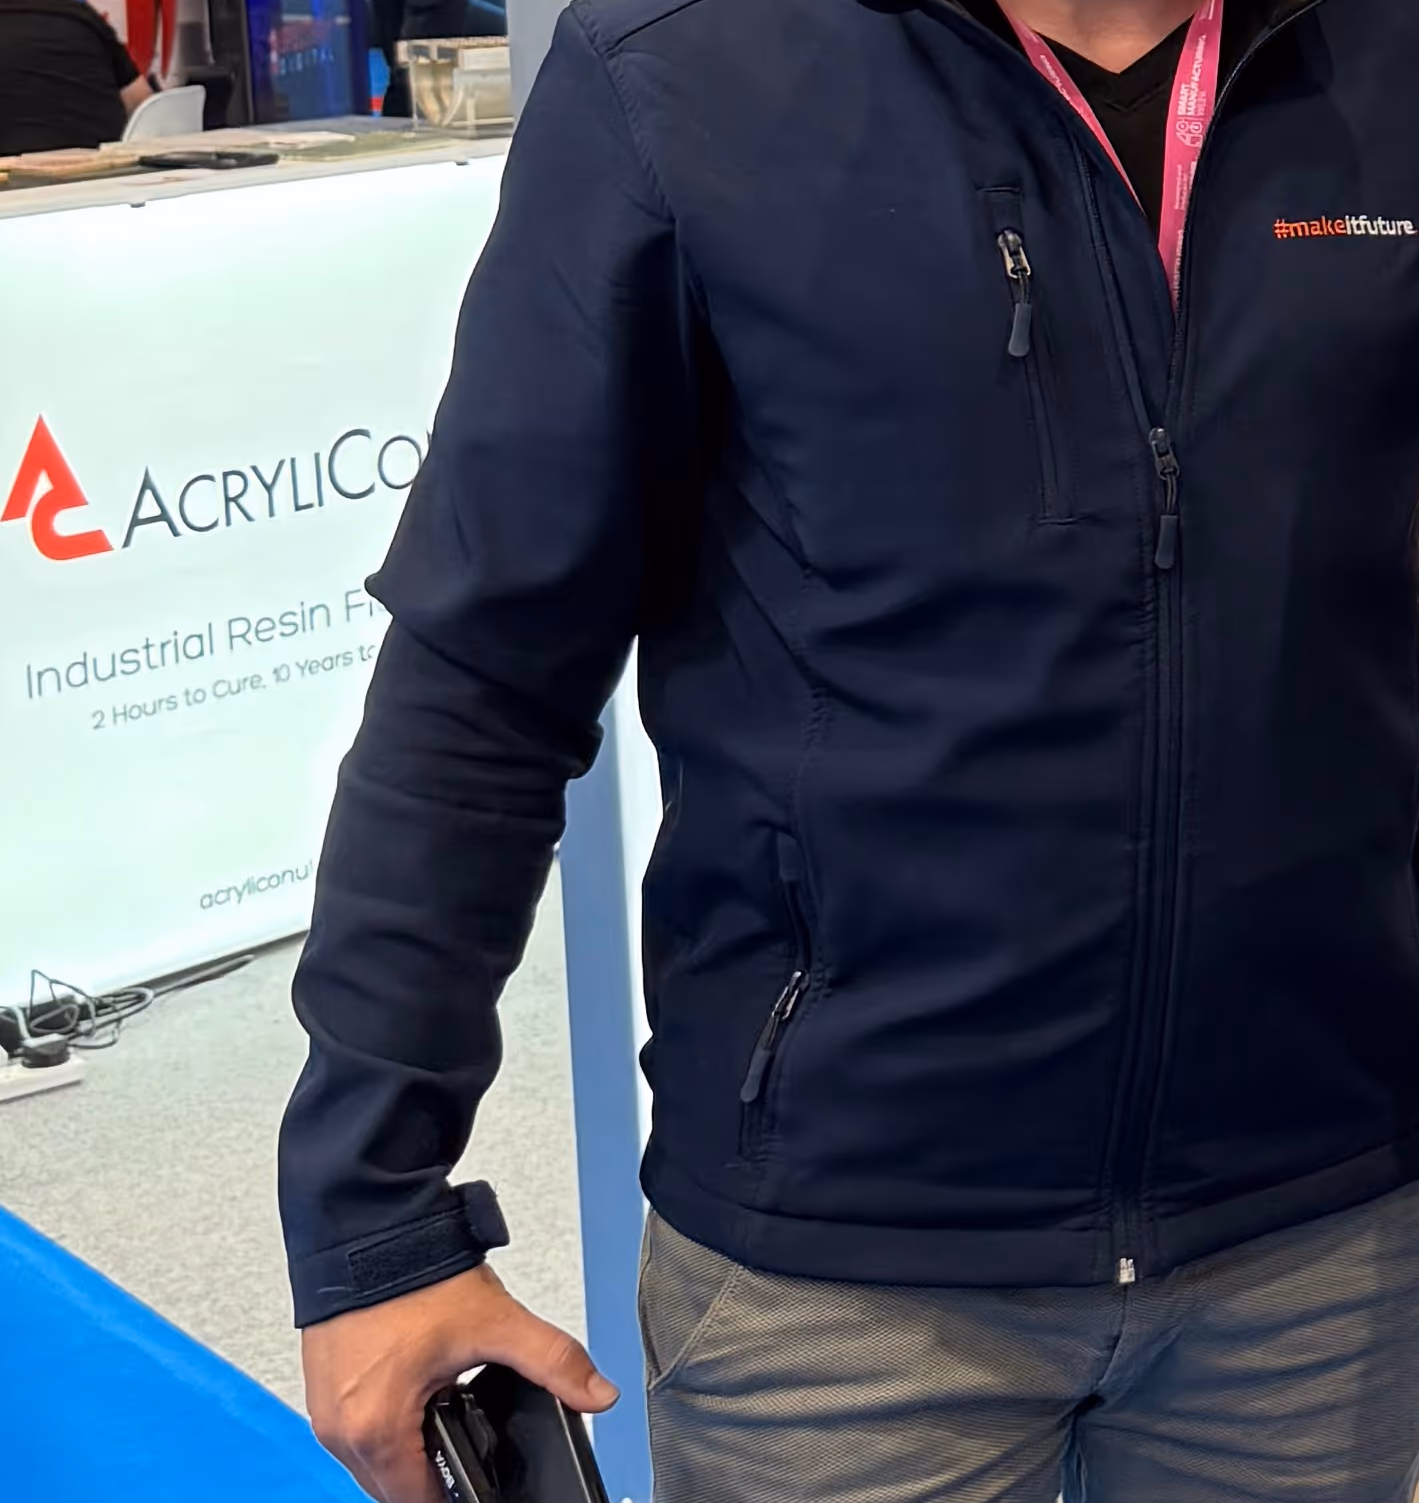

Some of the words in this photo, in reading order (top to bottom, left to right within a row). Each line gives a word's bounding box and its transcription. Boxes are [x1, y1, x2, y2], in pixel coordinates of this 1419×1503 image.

[26, 621, 213, 698] Industrial
[227, 600, 331, 651] Resin
[92, 710, 106, 731] 2
[113, 694, 178, 726] Hours
[185, 685, 206, 708] to
[272, 663, 291, 683] 10
[295, 650, 353, 678] Years
